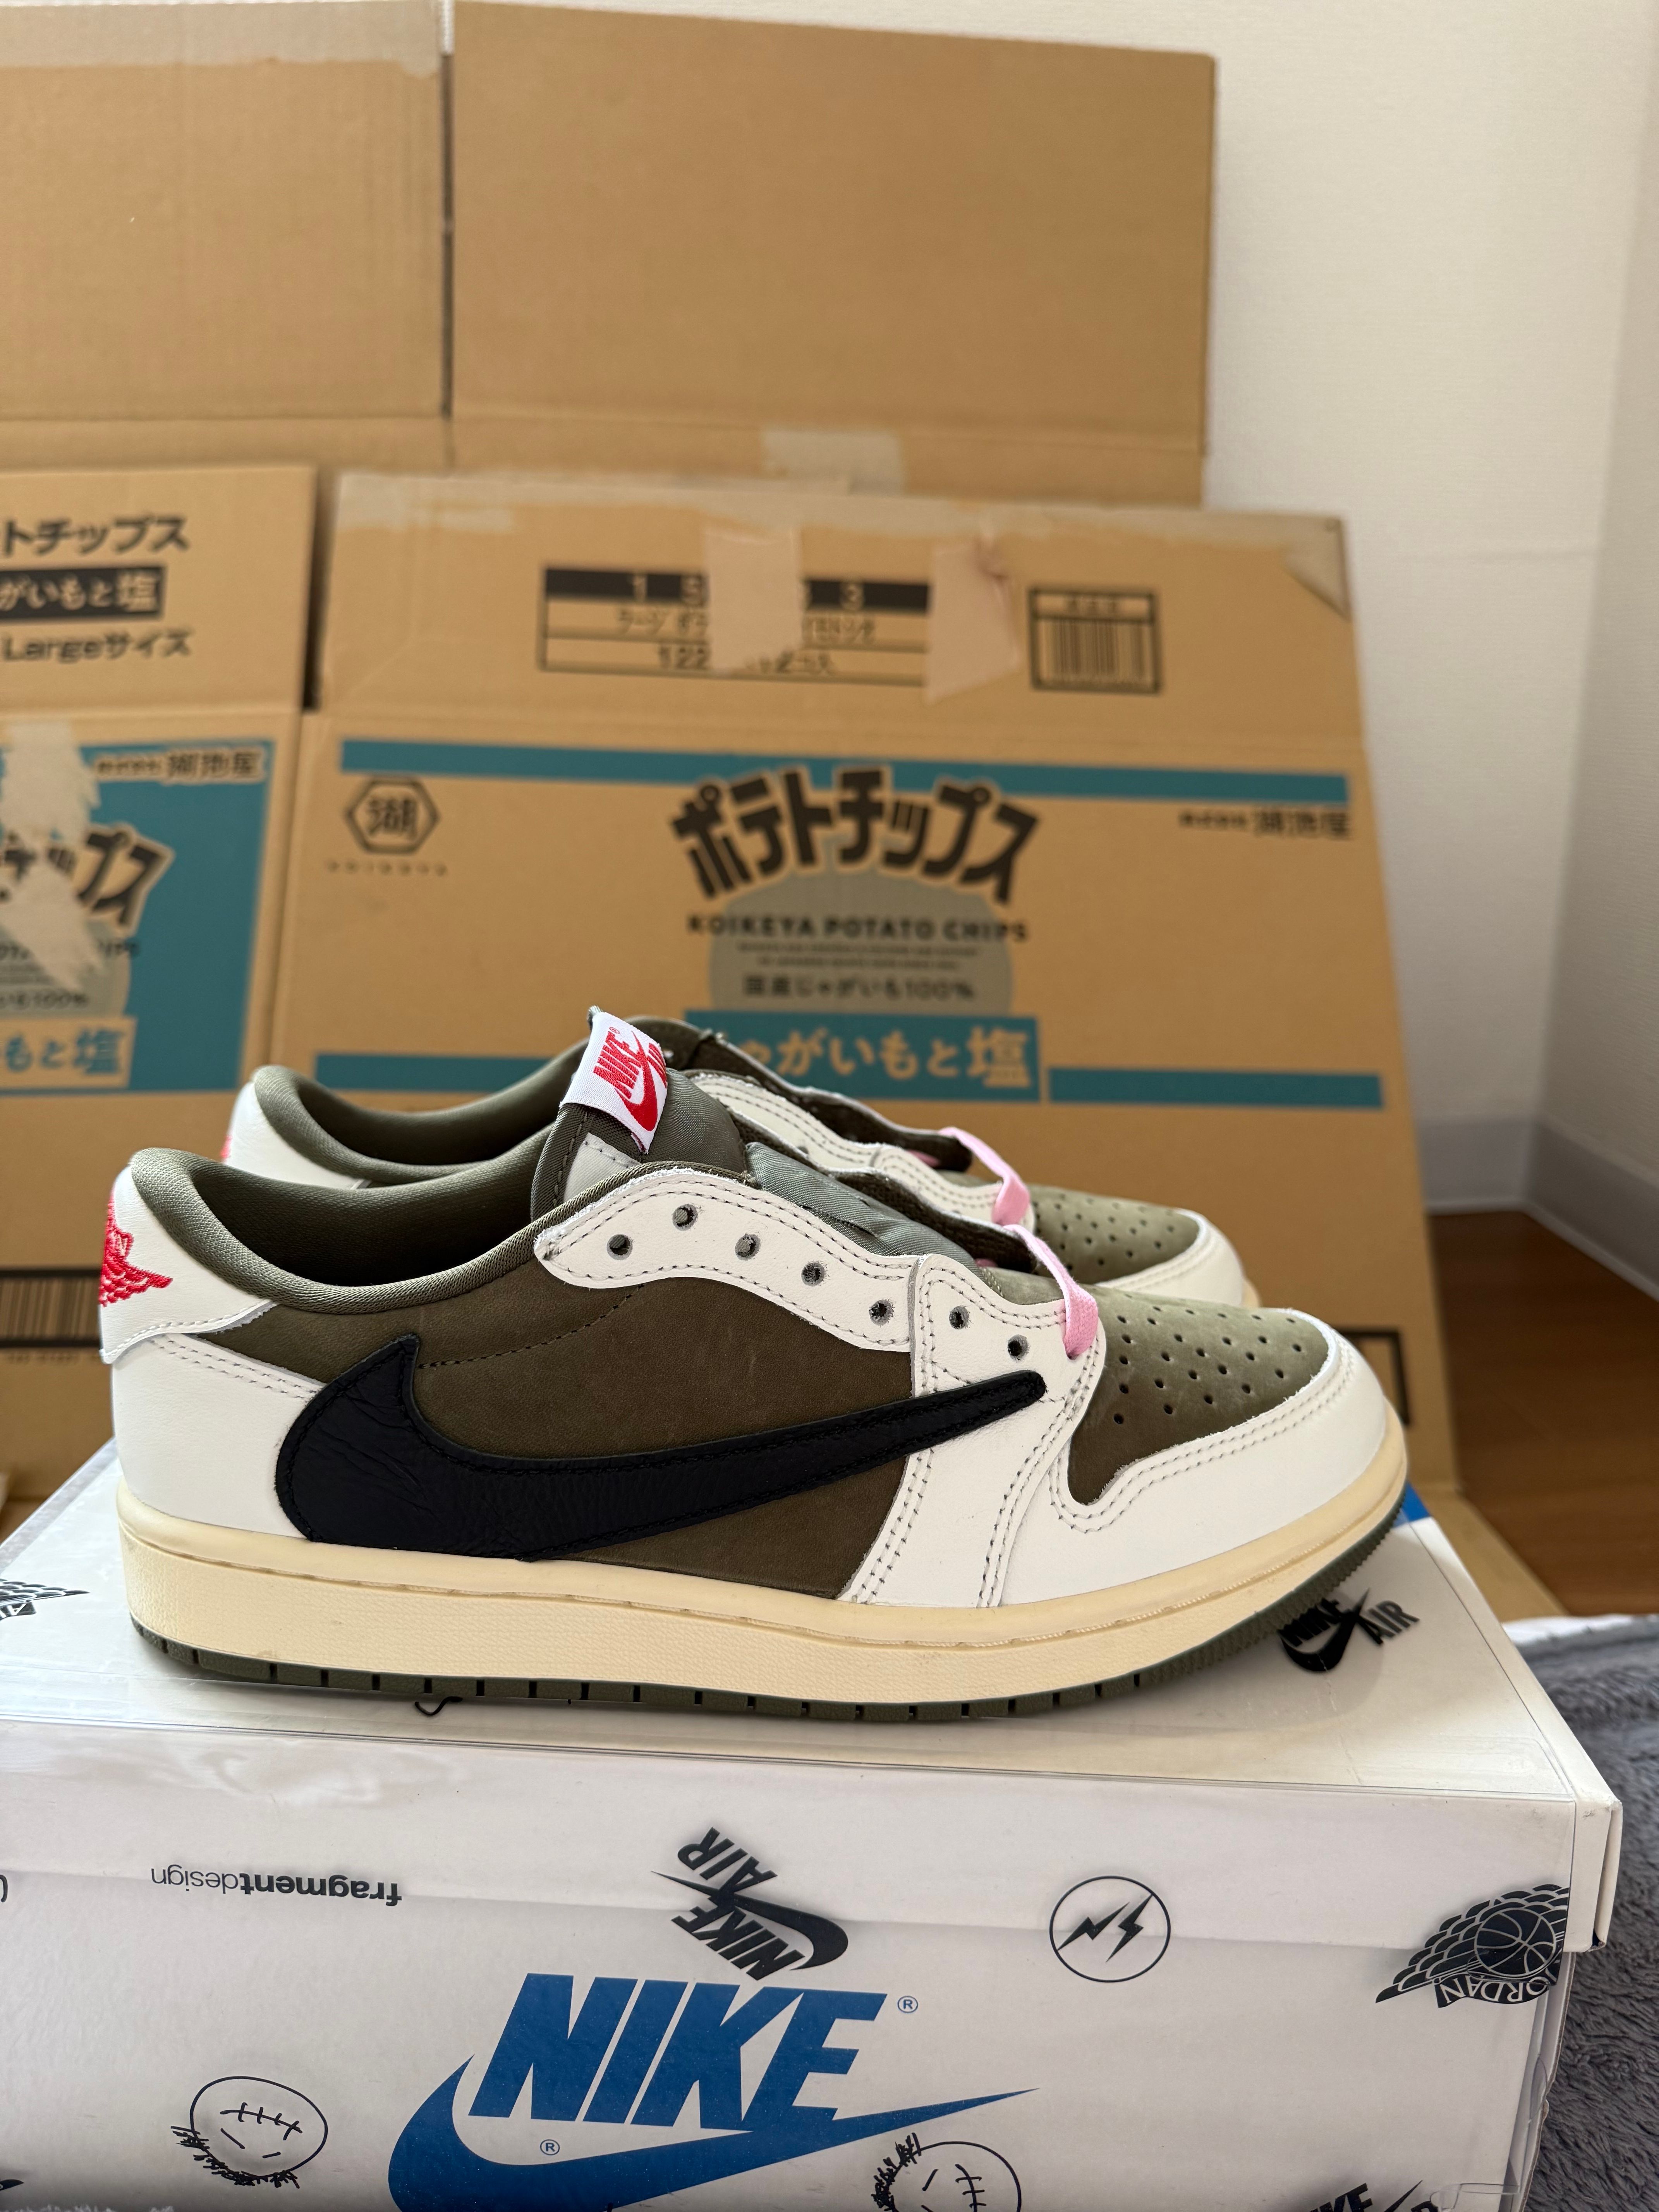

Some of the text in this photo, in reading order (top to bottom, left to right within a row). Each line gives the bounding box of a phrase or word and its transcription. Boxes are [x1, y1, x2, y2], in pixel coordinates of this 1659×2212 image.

[3, 515, 190, 556] トチップス
[672, 770, 1038, 904] ポテトチップス
[825, 918, 935, 942] POTATO
[943, 919, 1029, 943] CHIPS
[593, 1031, 647, 1099] NIKE
[1355, 1599, 1420, 1645] AIR
[150, 1864, 402, 1906] fragmentdesign
[677, 1826, 778, 1894] AIR
[670, 1896, 805, 1981] NIKE
[1440, 1974, 1549, 2004] ORDAN
[468, 1972, 888, 2131] NIKE
